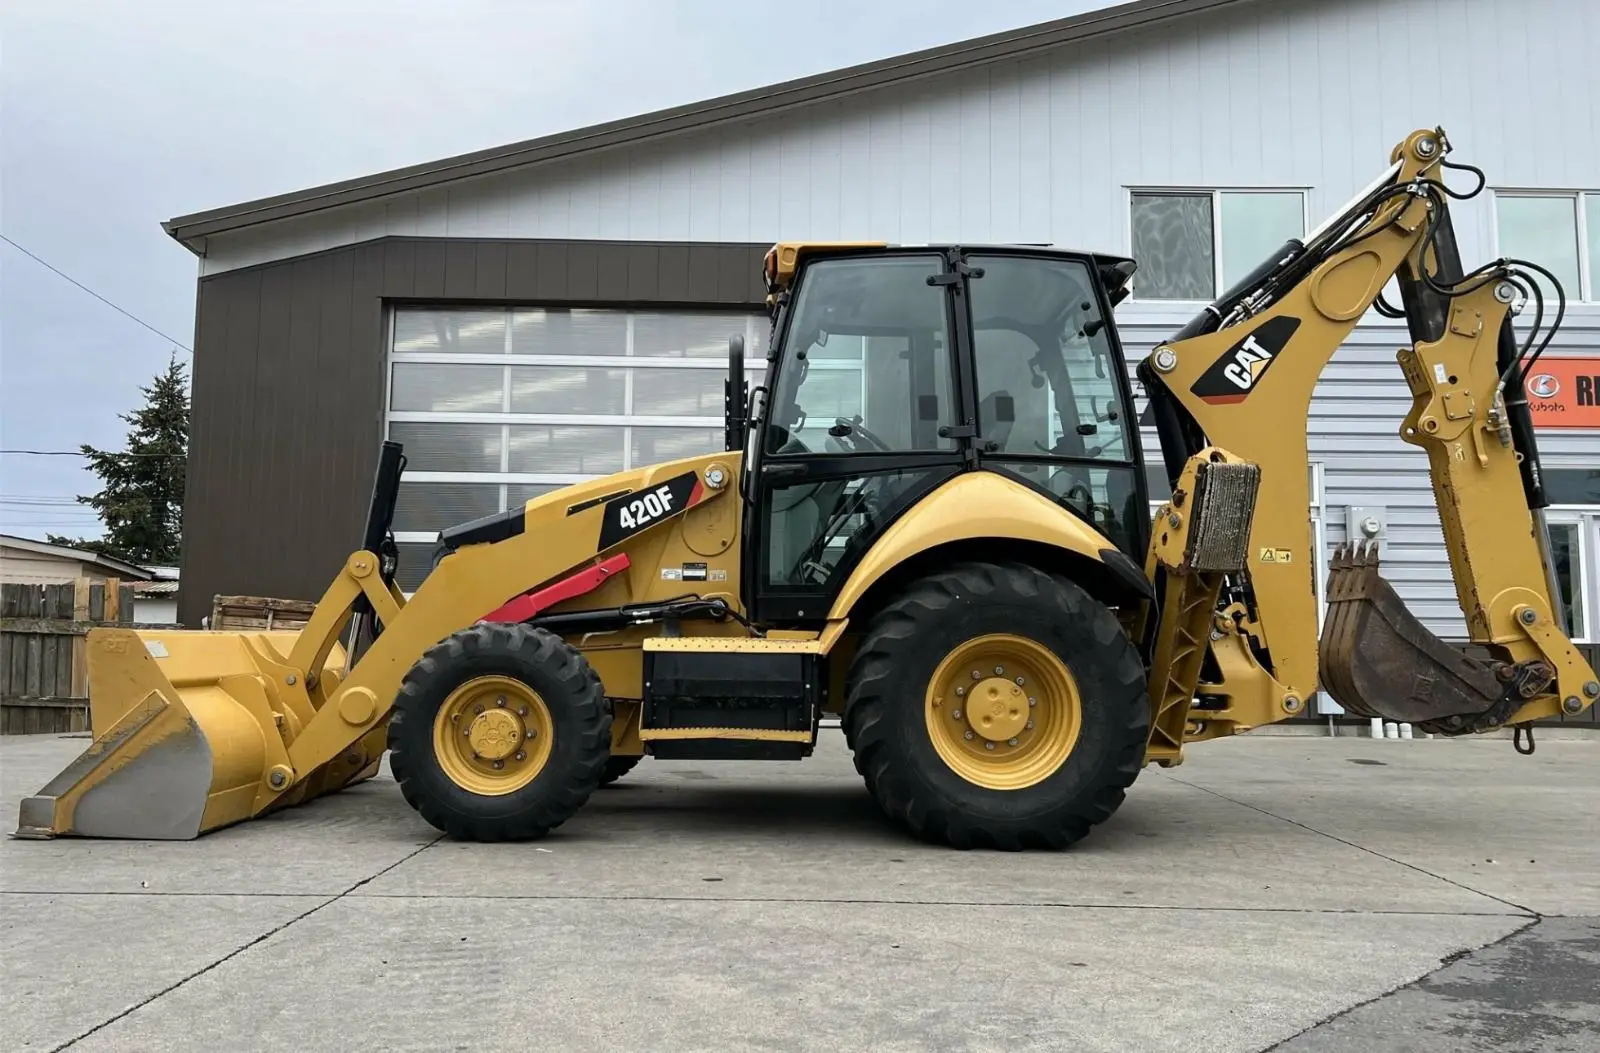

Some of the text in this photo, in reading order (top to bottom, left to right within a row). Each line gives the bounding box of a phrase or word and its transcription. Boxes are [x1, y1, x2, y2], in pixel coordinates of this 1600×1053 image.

[1224, 335, 1272, 389] CAT
[1576, 375, 1600, 406] R
[620, 485, 673, 528] 420F
